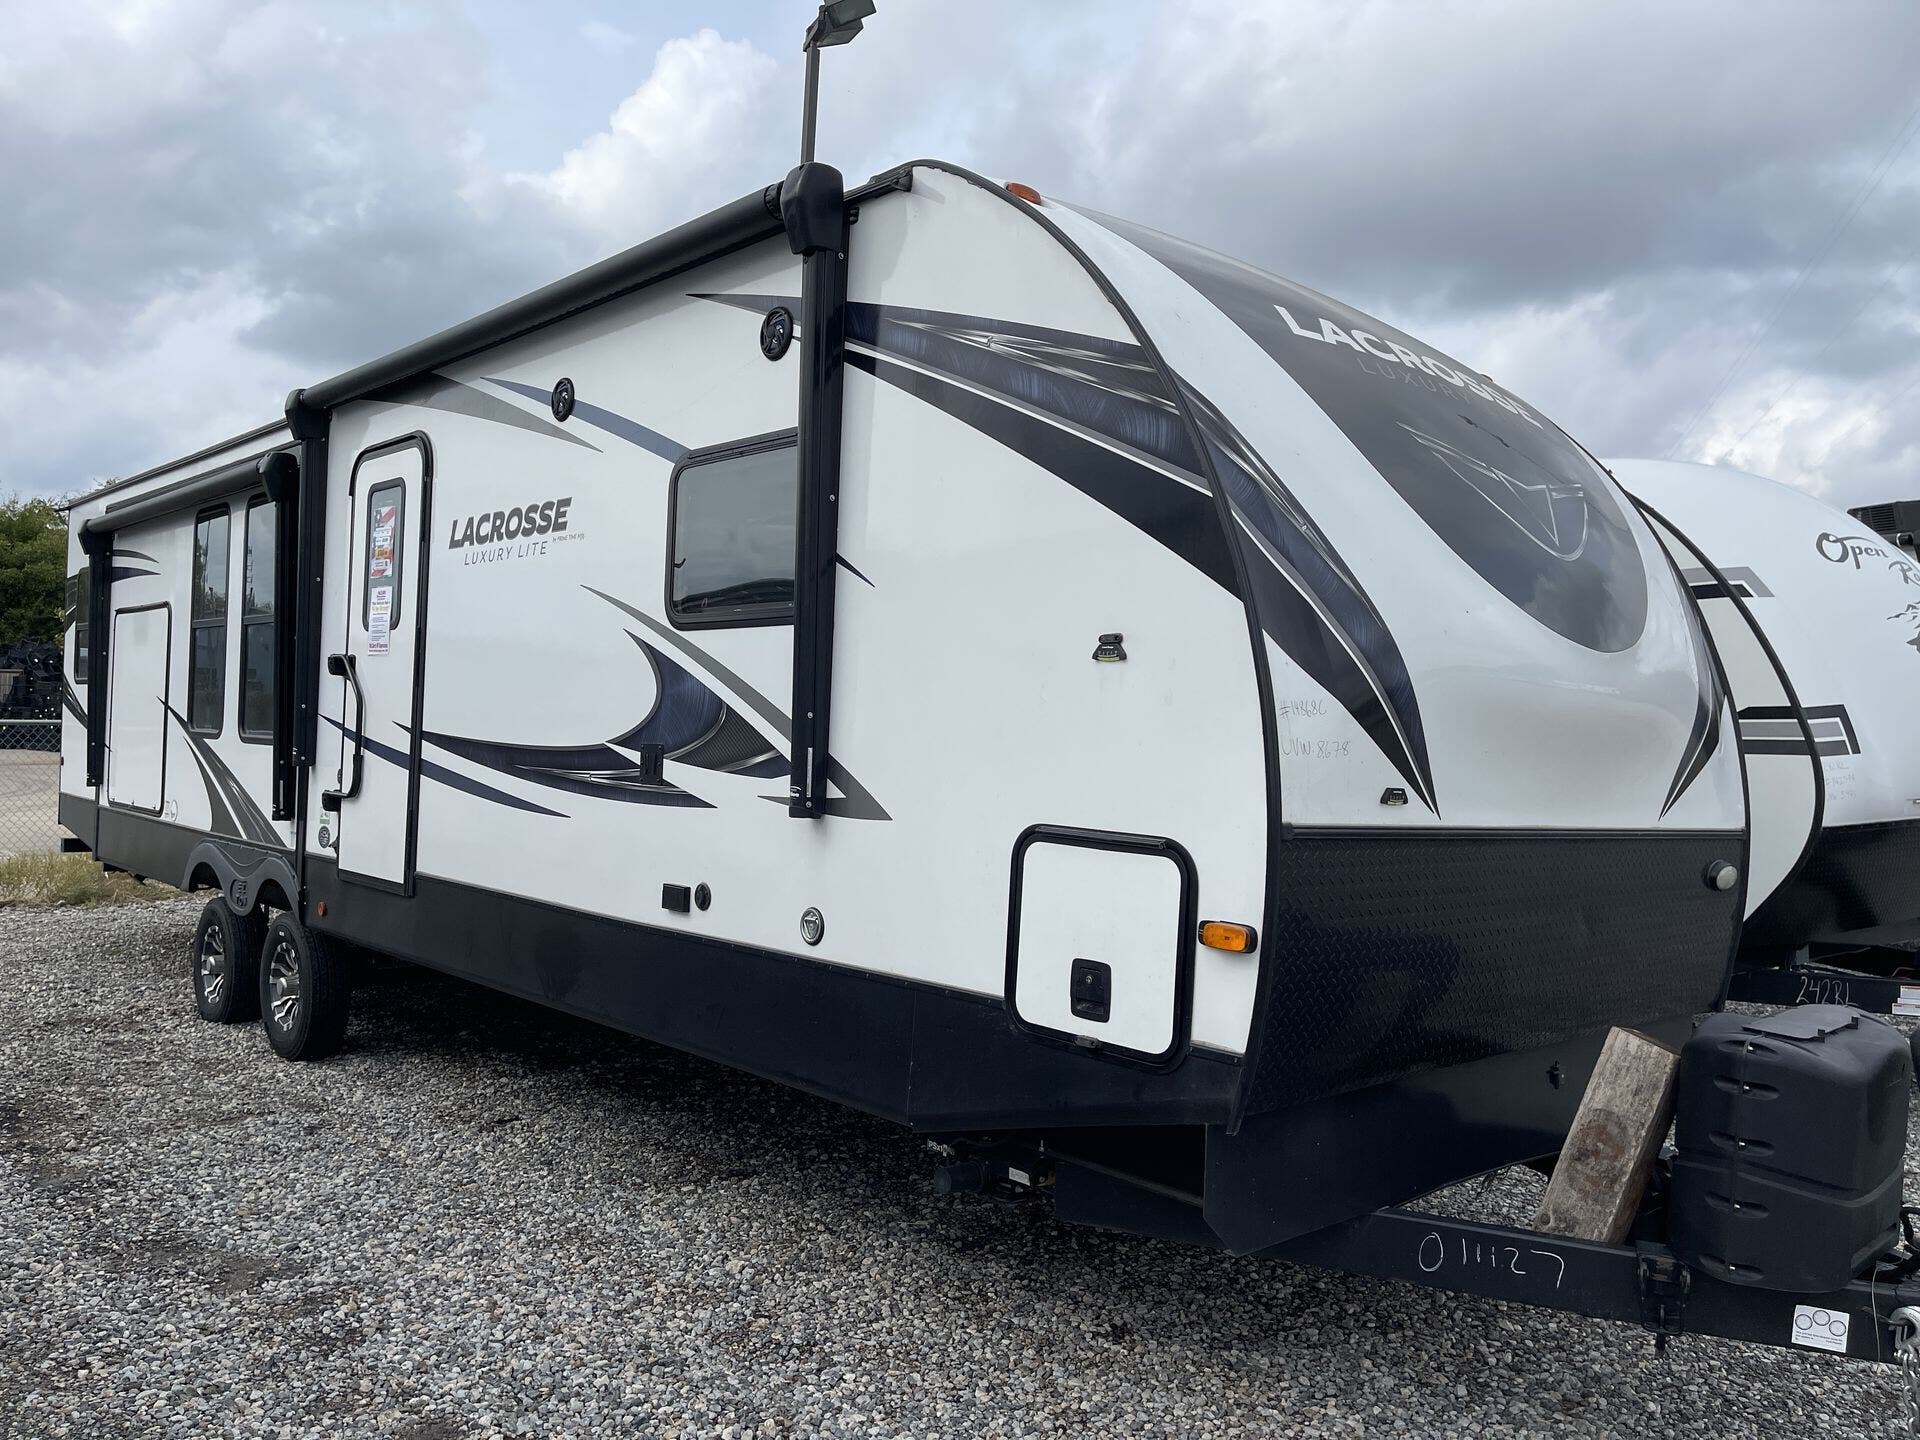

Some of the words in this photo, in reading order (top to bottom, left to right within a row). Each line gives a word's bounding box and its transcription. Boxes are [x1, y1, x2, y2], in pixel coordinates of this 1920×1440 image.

[1273, 304, 1544, 430] LACROSSE
[1356, 358, 1470, 404] LUXURY
[448, 496, 573, 550] LACROSSE
[464, 546, 513, 566] LUXURY
[518, 541, 548, 558] LITE
[1816, 532, 1889, 570] Open
